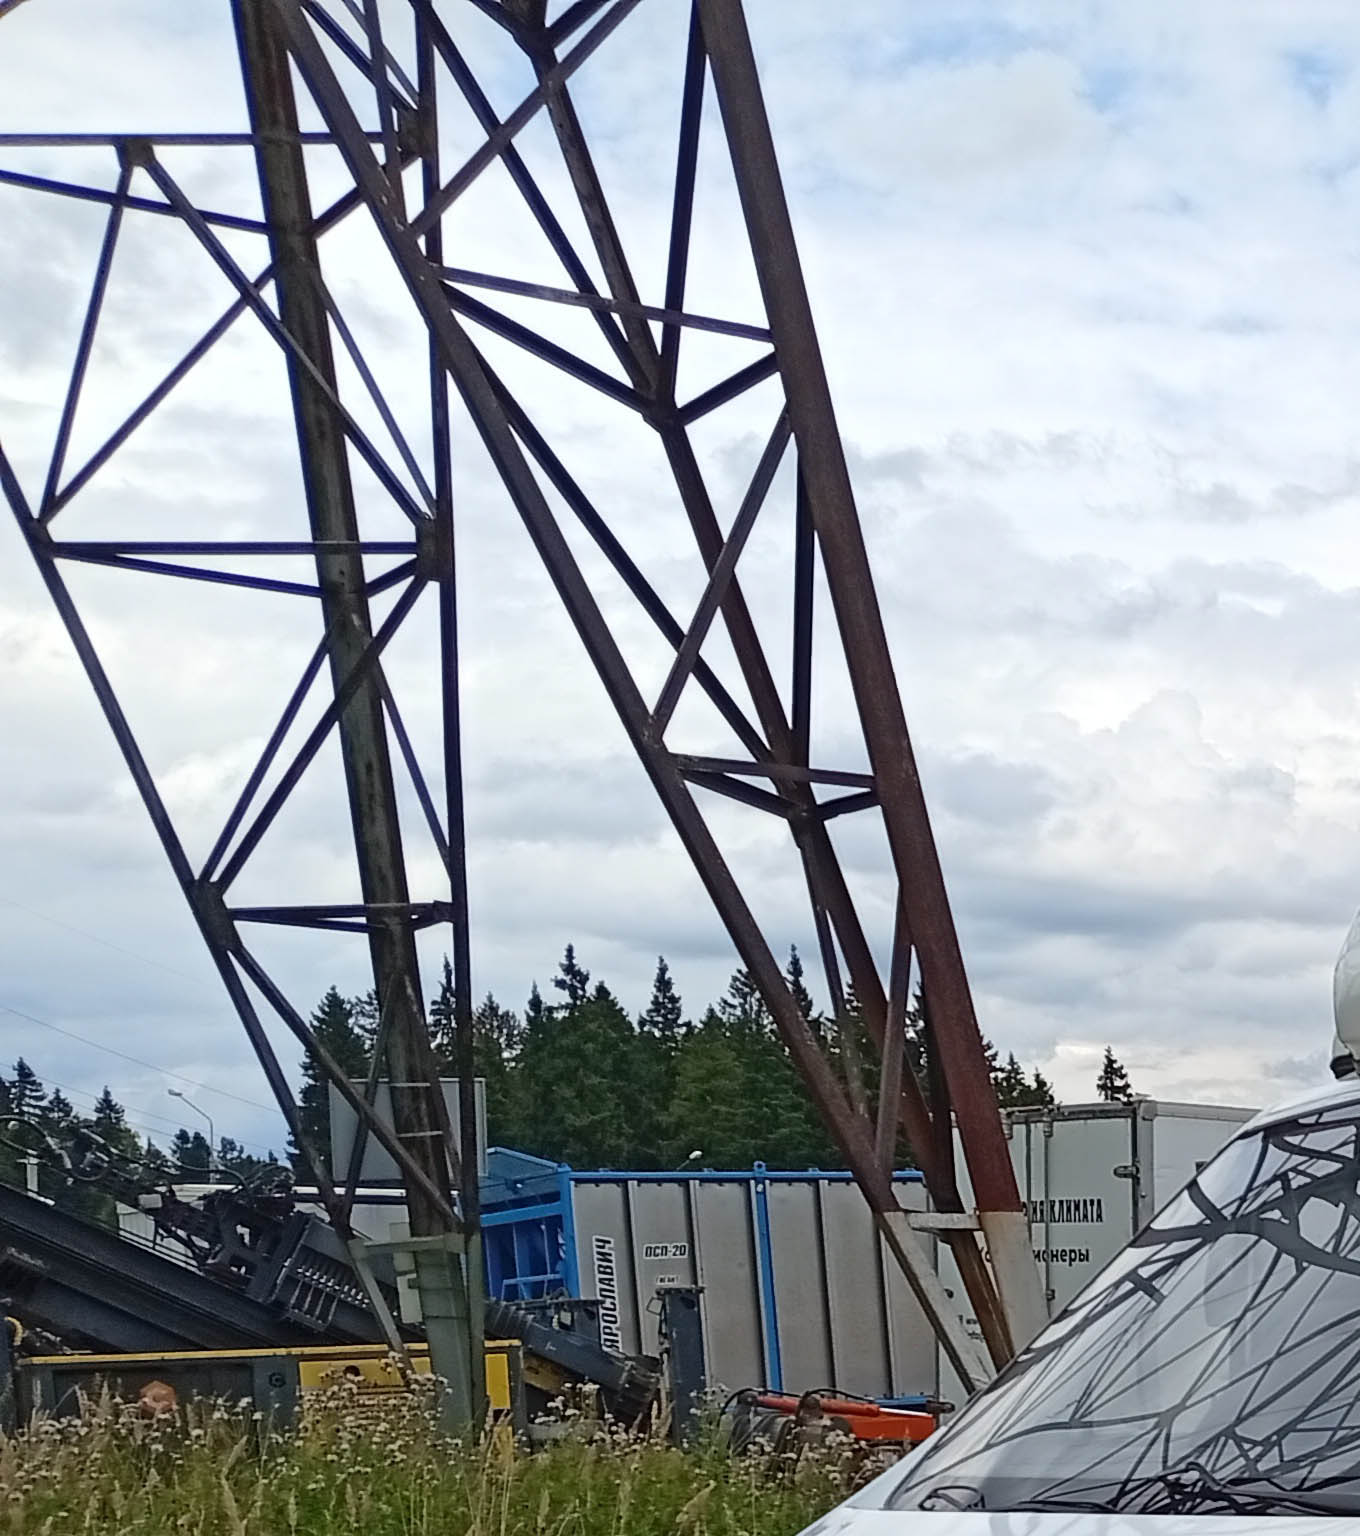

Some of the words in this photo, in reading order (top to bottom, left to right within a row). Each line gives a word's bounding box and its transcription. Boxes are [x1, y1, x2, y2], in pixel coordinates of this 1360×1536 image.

[1049, 1199, 1103, 1223] КЛИМАТА
[644, 1244, 688, 1258] ПСП-20
[595, 1237, 620, 1351] ЯРОСЛАВИЧ
